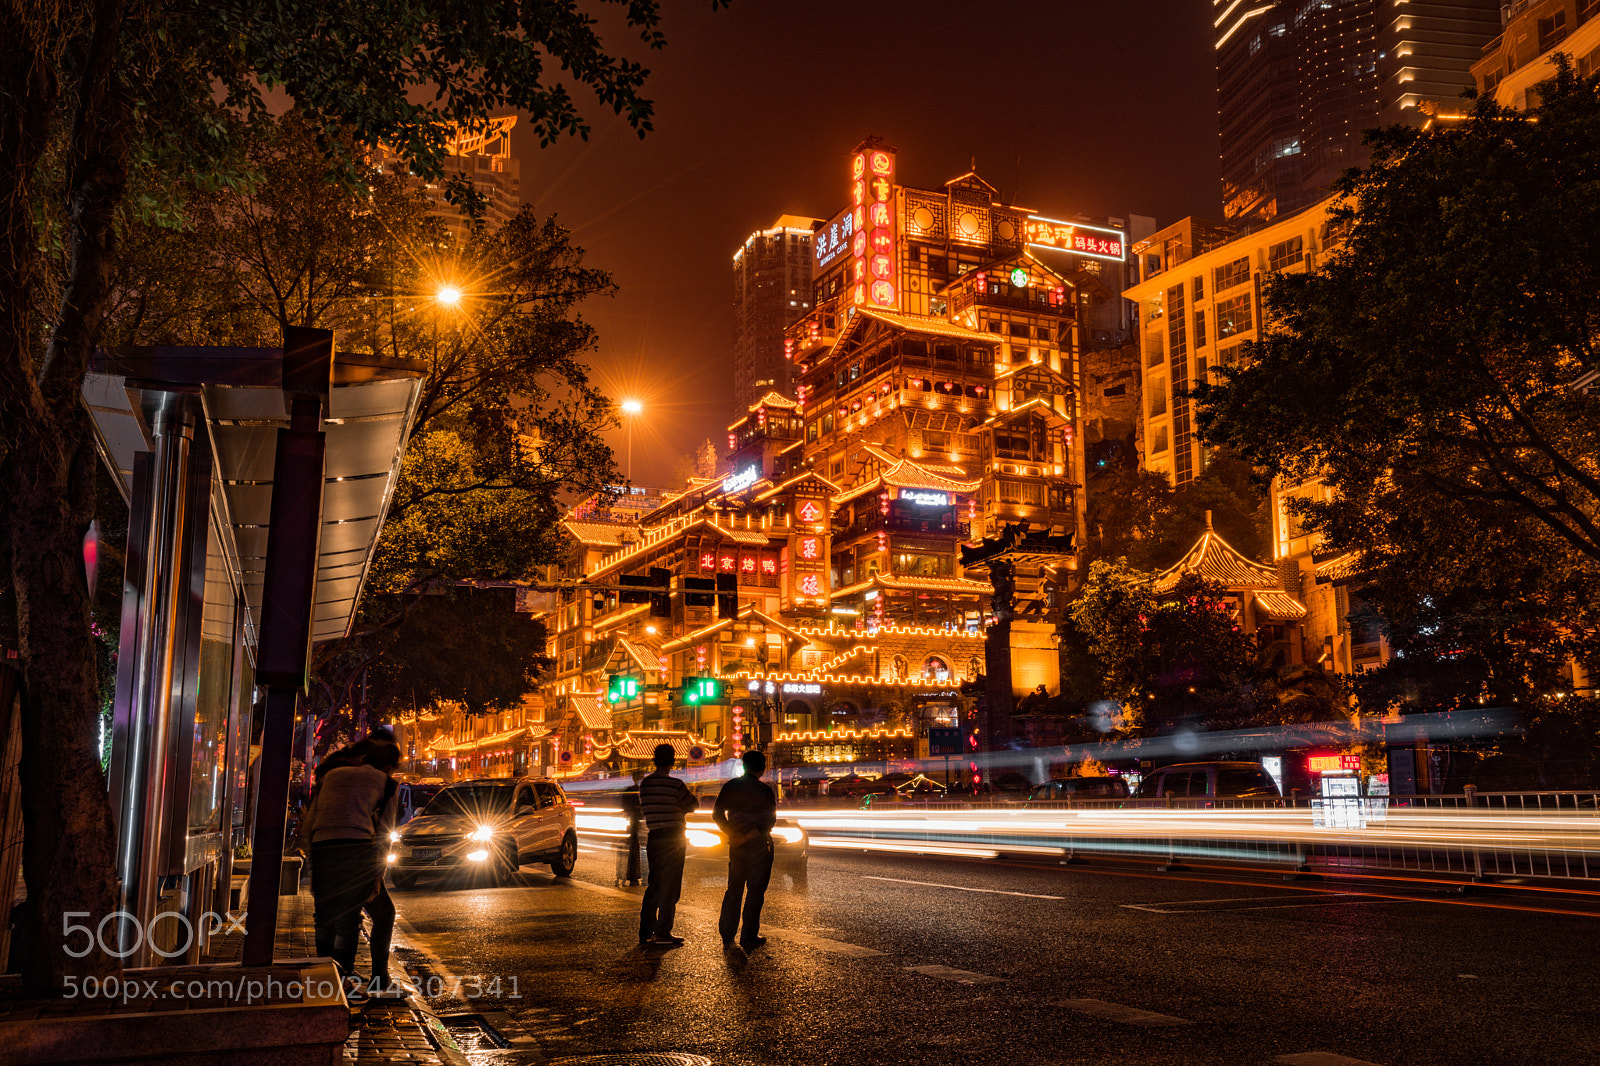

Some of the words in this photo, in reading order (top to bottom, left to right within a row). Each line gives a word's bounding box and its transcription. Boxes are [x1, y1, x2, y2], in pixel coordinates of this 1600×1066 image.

[816, 212, 853, 259] 洪崖洞
[1075, 236, 1121, 255] 码头火锅
[701, 554, 776, 574] 北京烤鸭
